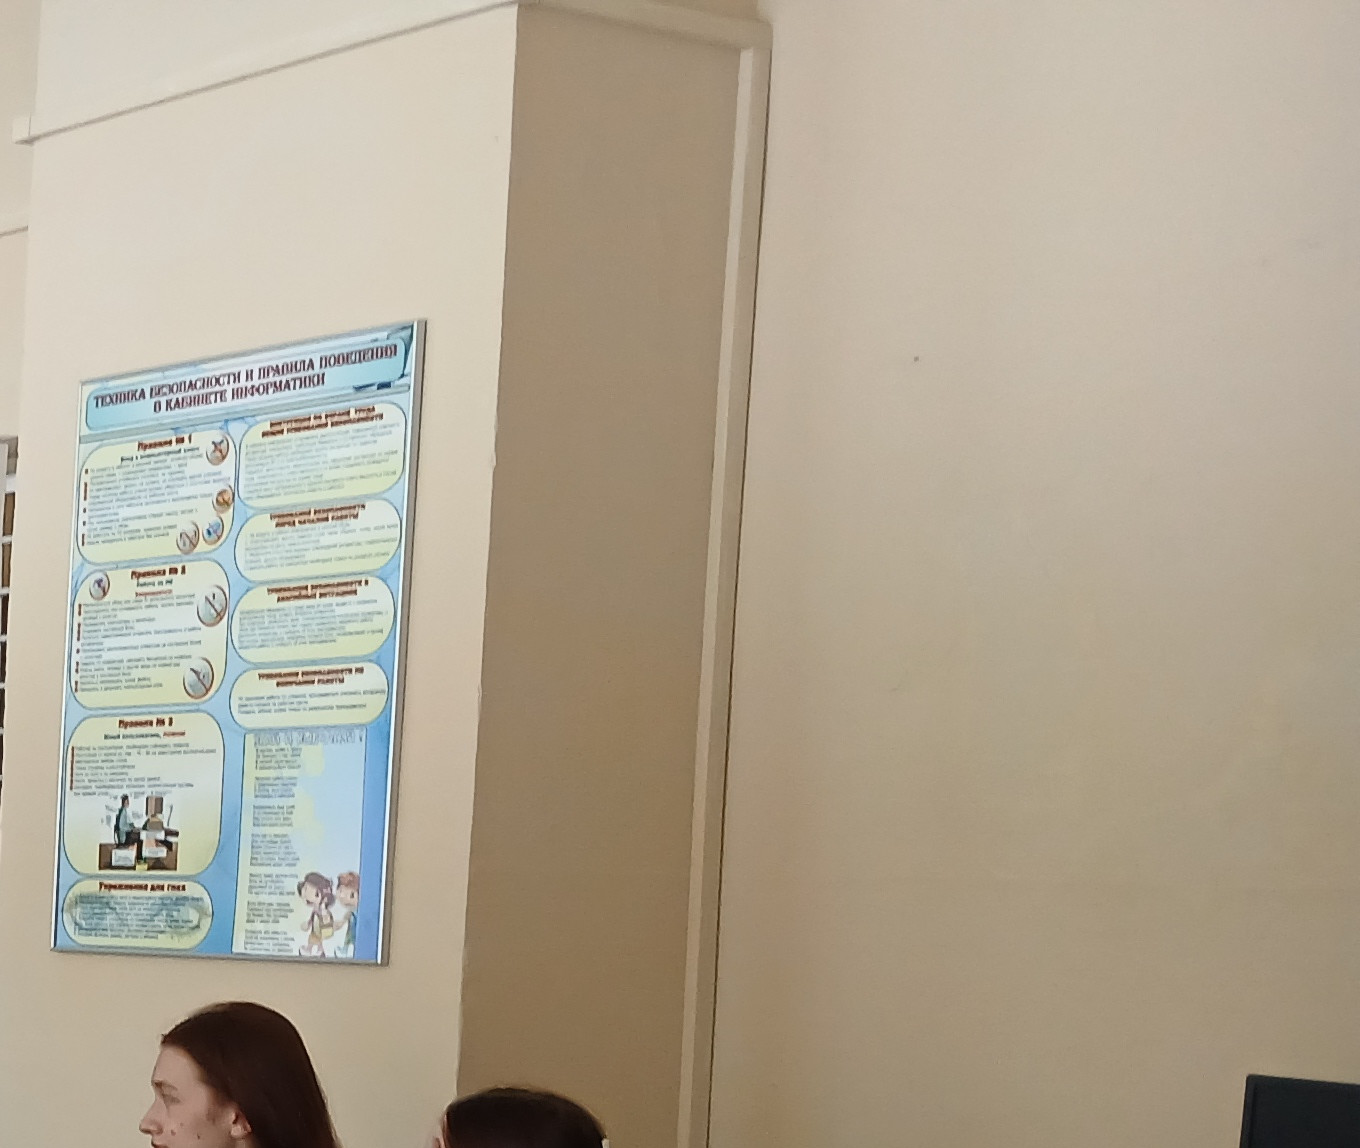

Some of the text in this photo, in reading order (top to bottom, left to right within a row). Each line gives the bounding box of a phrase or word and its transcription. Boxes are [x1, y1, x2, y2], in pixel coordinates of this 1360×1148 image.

[94, 388, 146, 408] ТЕХНИКА
[245, 368, 254, 382] И
[257, 358, 315, 381] ПРАВИЛА
[165, 389, 227, 412] КАБИНЕТЕ
[231, 372, 326, 400] ИНФОРМАТИКИ
